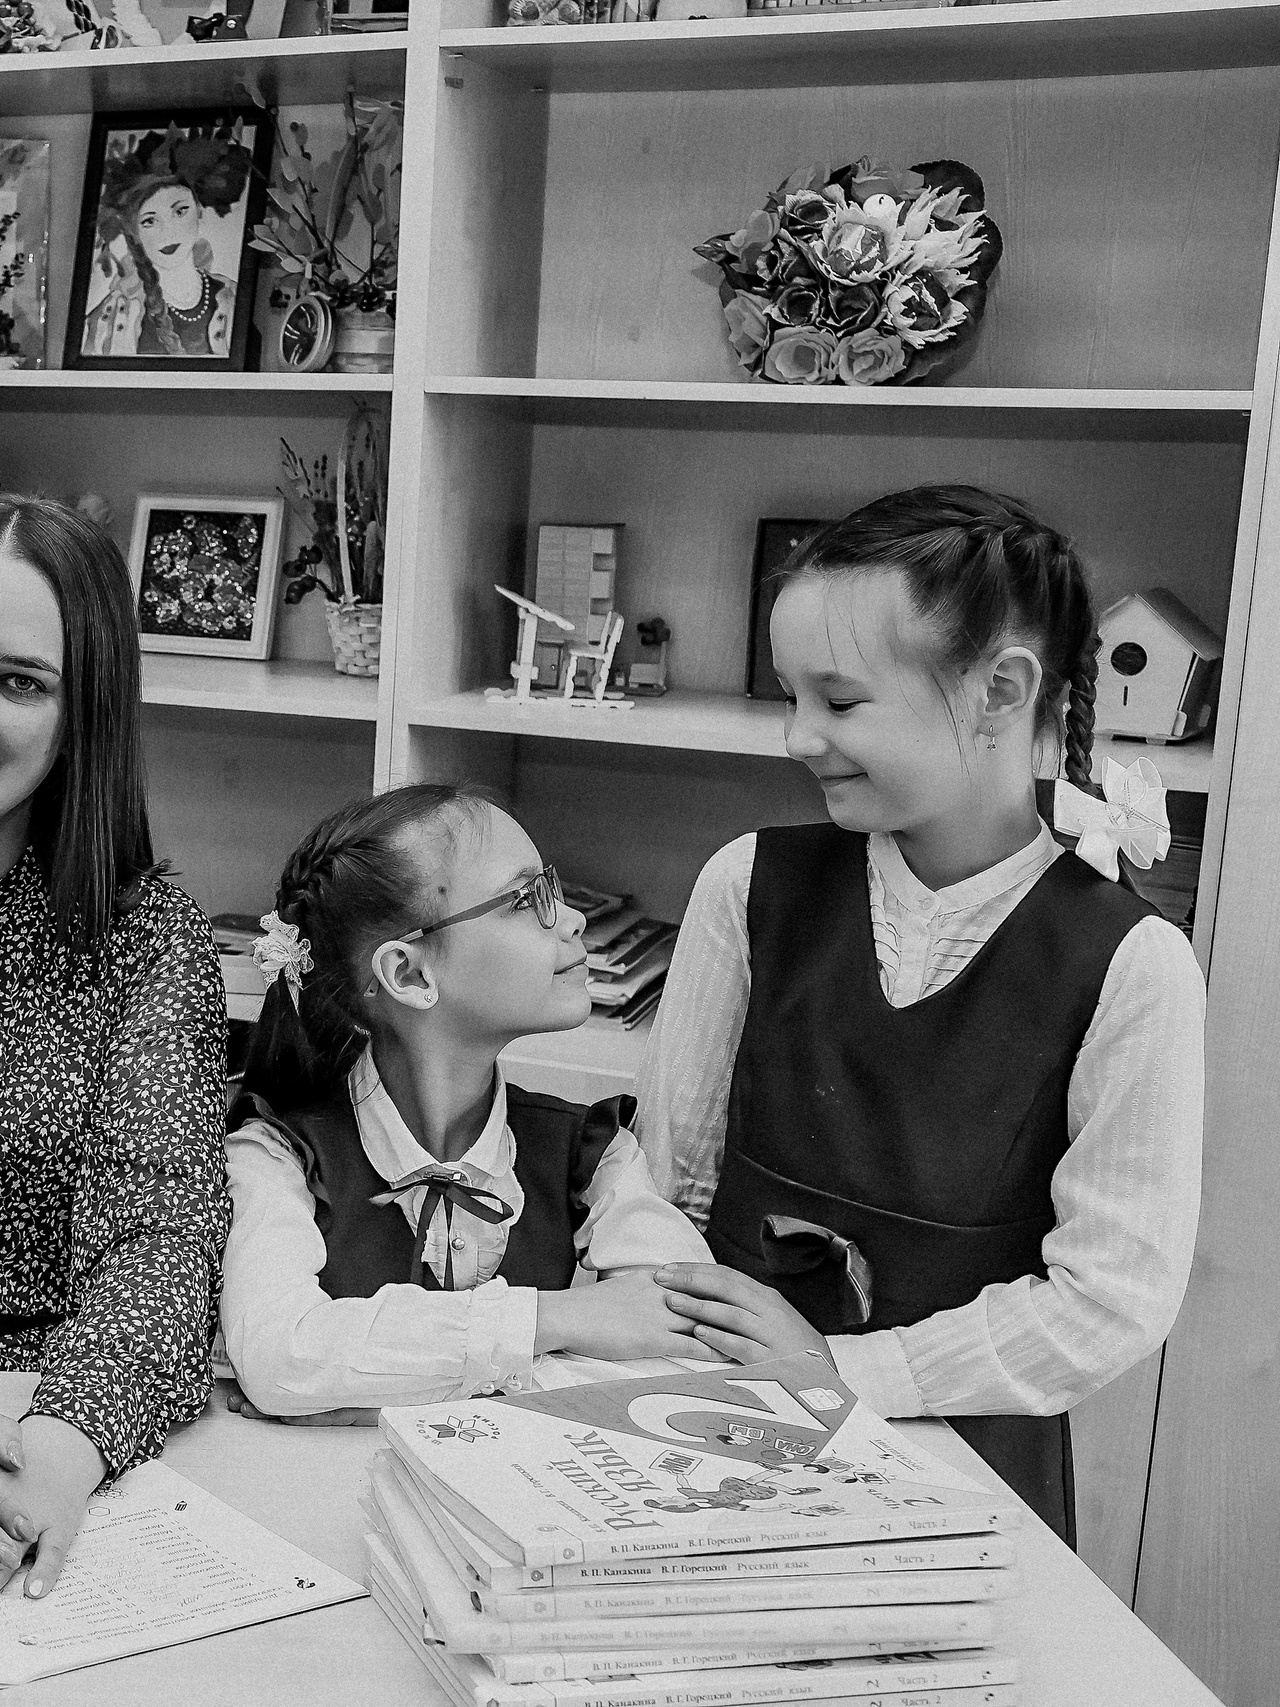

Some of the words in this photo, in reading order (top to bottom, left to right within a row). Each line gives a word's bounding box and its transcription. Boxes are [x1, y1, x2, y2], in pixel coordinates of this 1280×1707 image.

[623, 1379, 830, 1442] 2
[472, 1414, 500, 1439] РОССИИ
[775, 1440, 810, 1453] ОНА
[656, 1451, 696, 1473] МЫ
[541, 1458, 664, 1530] Русский
[901, 1496, 944, 1506] 2
[633, 1541, 679, 1552] Канакина
[707, 1535, 752, 1547] Горецкий
[760, 1533, 800, 1542] Русский
[805, 1530, 829, 1538] язык
[909, 1520, 937, 1529] Часть
[603, 1566, 652, 1576] Канакина
[681, 1563, 728, 1574] Горецкий
[737, 1562, 779, 1571] Русский
[783, 1561, 810, 1569] язык
[894, 1554, 925, 1564] Часть
[615, 1659, 663, 1670] Канакина
[691, 1653, 738, 1665] Горецкий
[747, 1650, 786, 1660] Русский
[685, 1691, 732, 1703] Горецкий
[741, 1688, 784, 1698] Русский
[789, 1686, 815, 1694] язык
[898, 1676, 927, 1684] Часть
